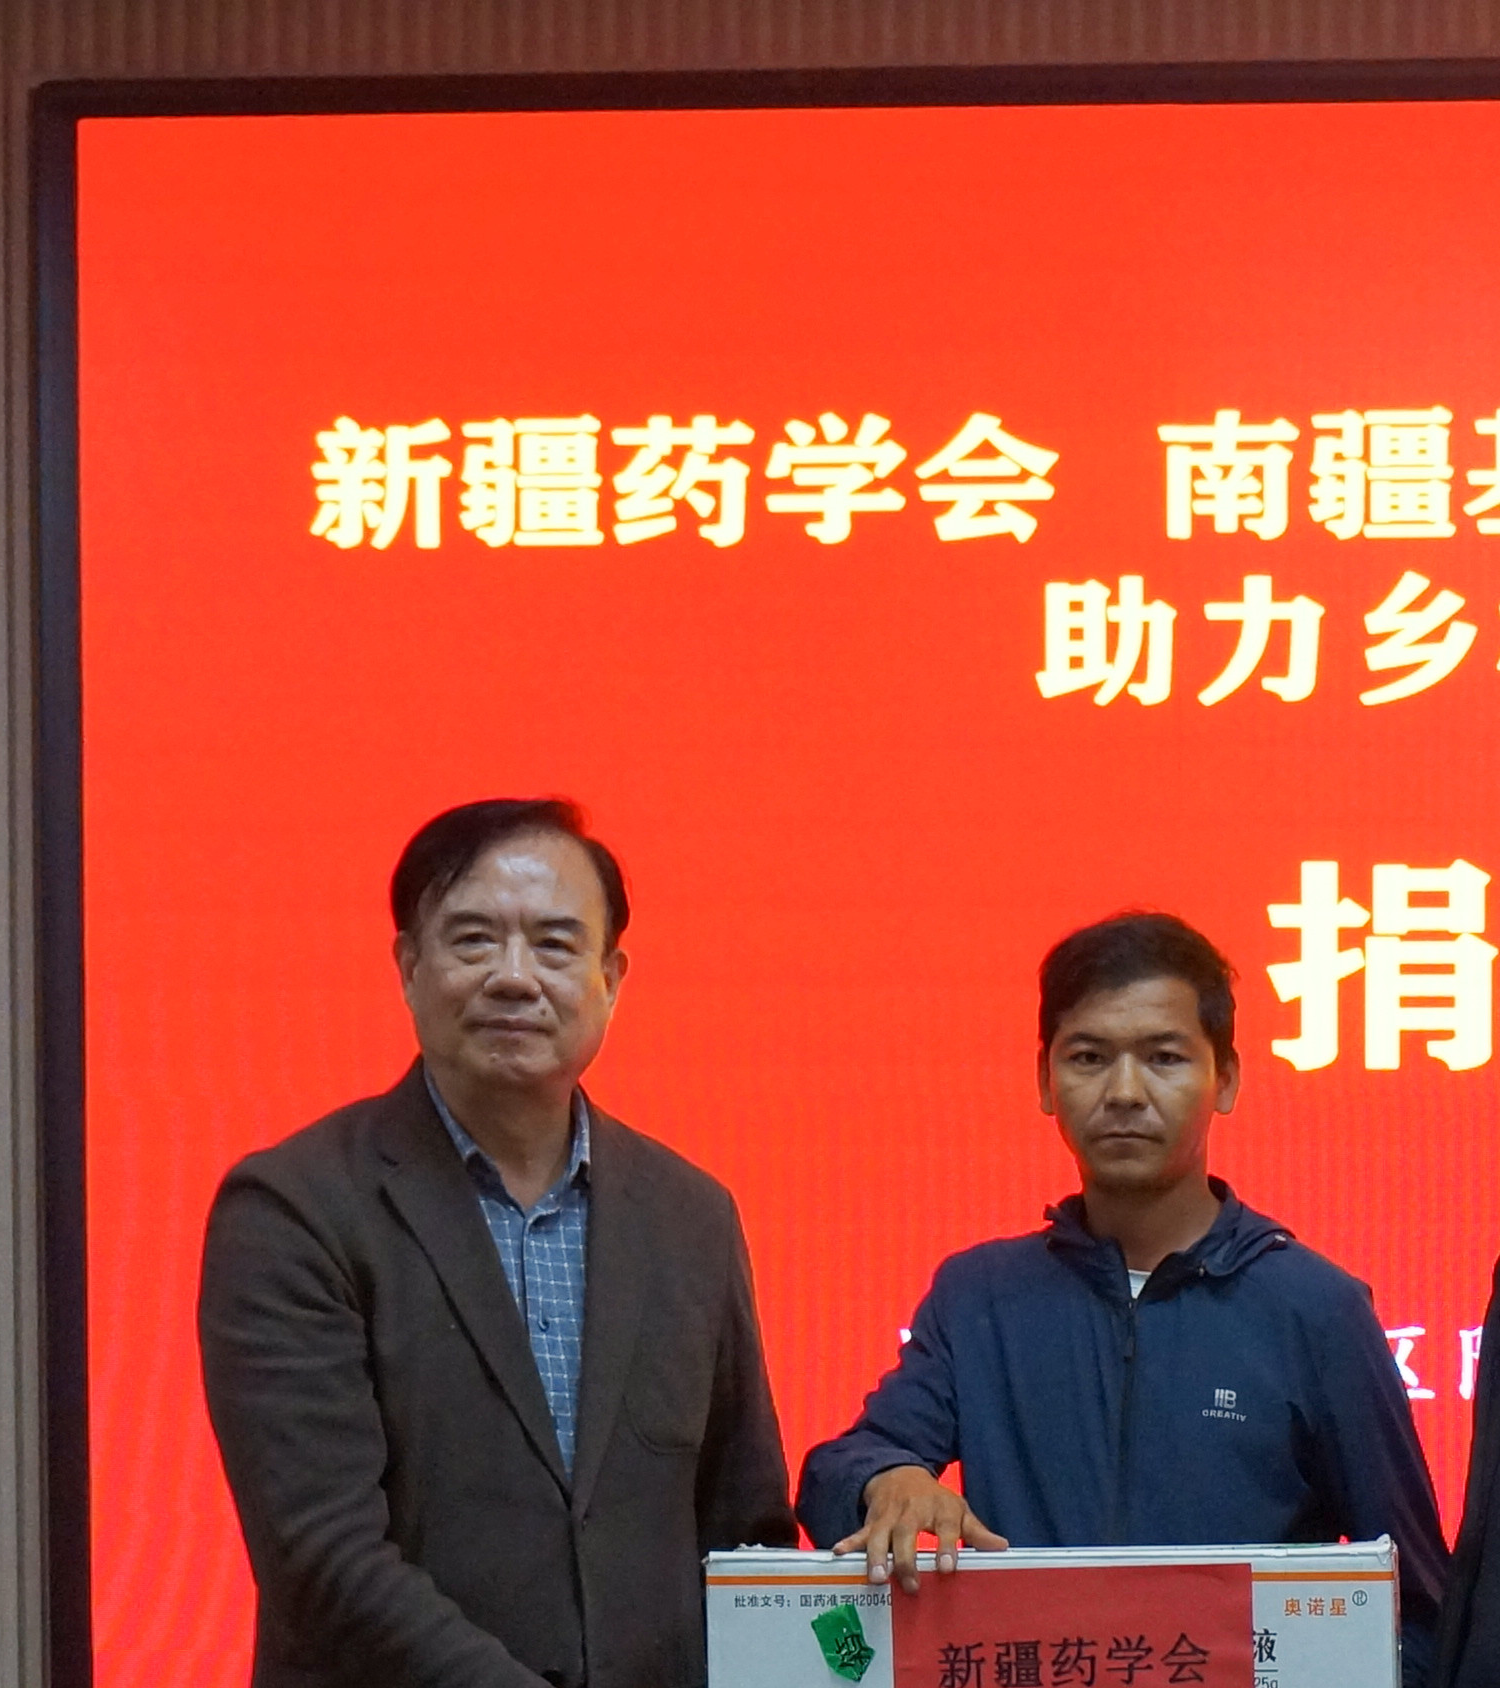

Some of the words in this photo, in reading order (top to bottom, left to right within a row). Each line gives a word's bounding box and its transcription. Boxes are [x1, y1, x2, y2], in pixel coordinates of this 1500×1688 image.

[308, 411, 1060, 550] 新疆药学会
[1284, 1597, 1348, 1617] 奥诺星
